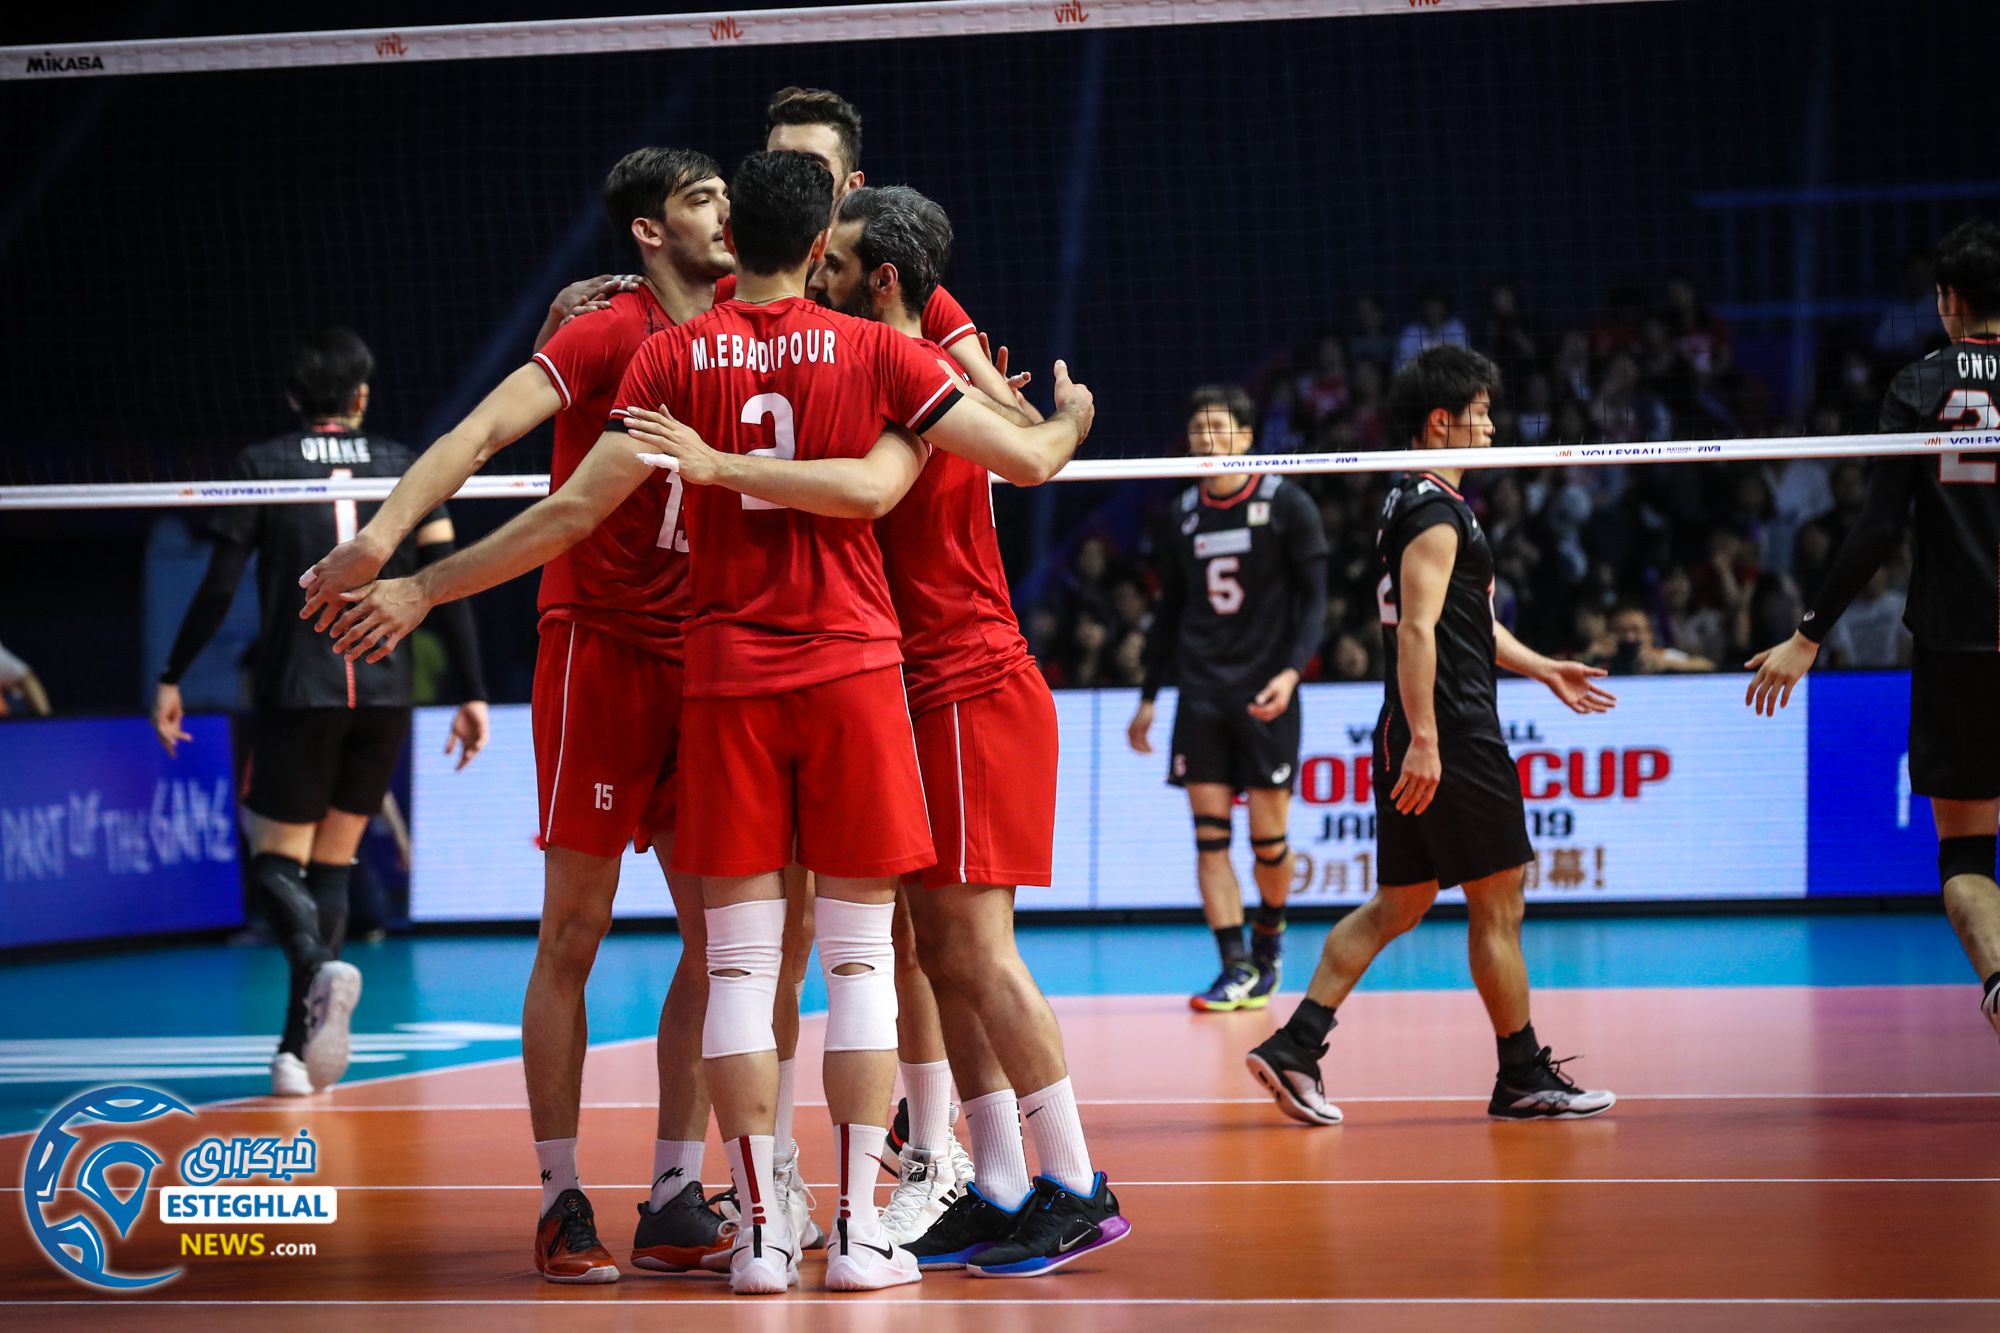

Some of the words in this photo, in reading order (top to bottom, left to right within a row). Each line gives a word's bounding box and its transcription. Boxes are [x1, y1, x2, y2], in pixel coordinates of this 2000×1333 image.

[709, 15, 744, 41] VNL
[1054, 0, 1089, 24] VNL
[691, 328, 837, 374] M.EBADIPOUR
[1956, 351, 2000, 381] ONO
[740, 391, 796, 511] 2
[1205, 556, 1245, 615] 5
[1515, 748, 1672, 801] CUP
[593, 782, 614, 811] 15
